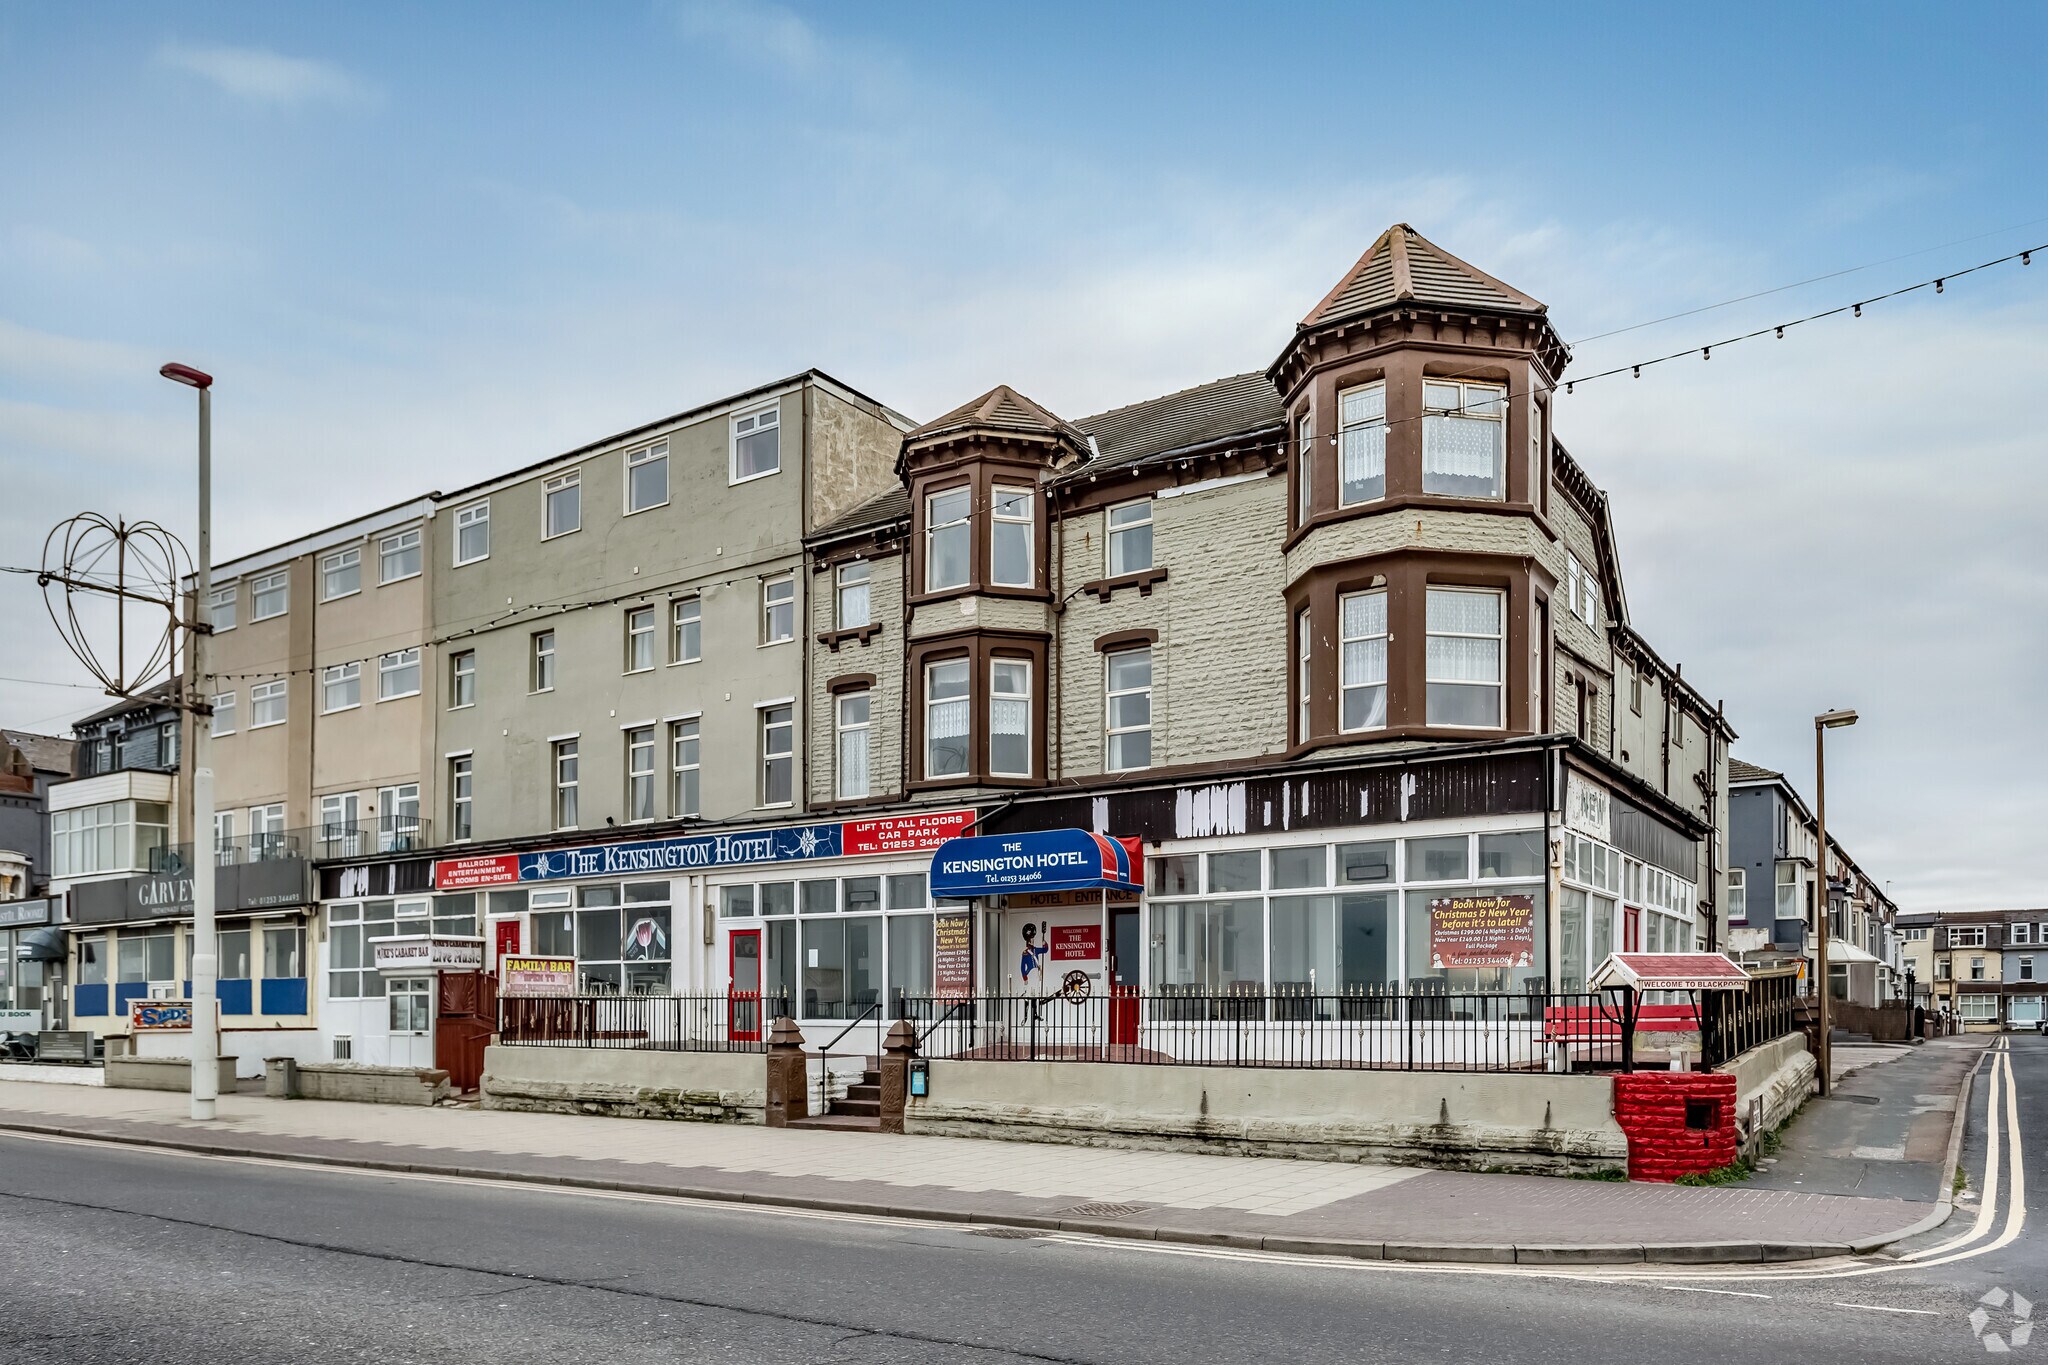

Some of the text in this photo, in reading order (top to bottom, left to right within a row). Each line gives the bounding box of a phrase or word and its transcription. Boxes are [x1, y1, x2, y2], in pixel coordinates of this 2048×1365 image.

[856, 815, 963, 832] LIFT TO ALL FLOORS
[878, 827, 939, 840] CAR PARK
[857, 836, 961, 851] TEL: 01253 3440
[1002, 842, 1022, 852] THE
[566, 834, 778, 875] THE KENSINGTON HOTEL
[457, 859, 496, 869] BALLROOM
[942, 851, 1088, 874] KENSINGTON HOTEL
[448, 865, 506, 877] ENTERTAINMENT
[455, 876, 479, 884] ROOMS
[480, 873, 512, 882] EN-SUITE
[985, 871, 1042, 883] Tel. 01253 344066
[1030, 890, 1133, 905] HOTEL ENTRANCE
[1453, 899, 1510, 910] Book Now for
[1434, 907, 1530, 919] Christmas & New Year
[950, 918, 963, 928] Now
[1442, 917, 1521, 930] before it's to late!!
[936, 928, 966, 937] Christmas
[1489, 928, 1506, 936] Nights
[940, 936, 969, 944] New Year
[1068, 934, 1082, 942] THE
[1489, 935, 1506, 943] Nights
[1055, 942, 1096, 950] KENSINGTON
[394, 947, 417, 958] CABARET
[418, 946, 429, 957] BAR
[432, 949, 481, 964] Live Music
[506, 960, 572, 972] FAMILY BAR
[1451, 957, 1462, 965] Tel:
[1463, 957, 1485, 965] 01253
[523, 973, 556, 982] OPEN TO
